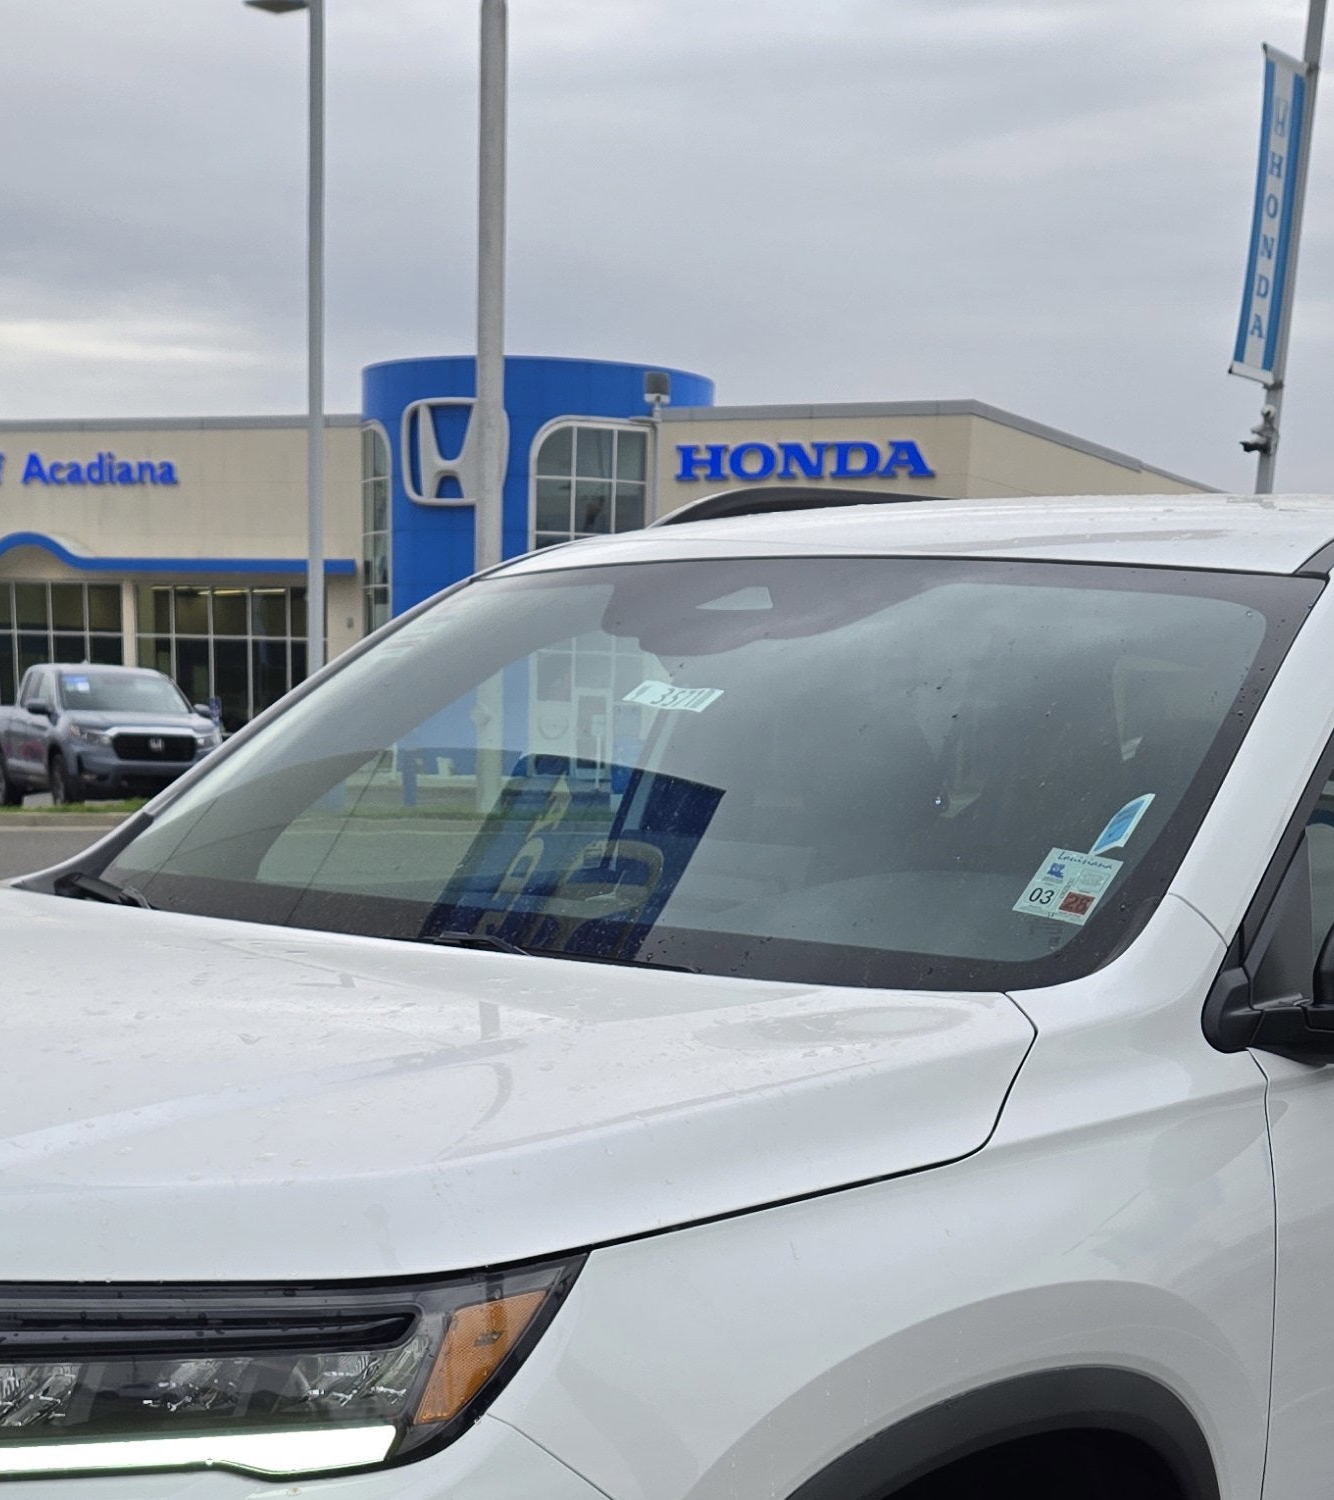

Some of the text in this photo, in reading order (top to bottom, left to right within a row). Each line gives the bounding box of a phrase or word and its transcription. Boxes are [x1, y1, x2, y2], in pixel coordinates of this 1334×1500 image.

[1250, 155, 1284, 339] HONDA
[21, 452, 179, 487] Acadiana
[675, 439, 936, 482] HONDA
[1028, 887, 1055, 905] 03
